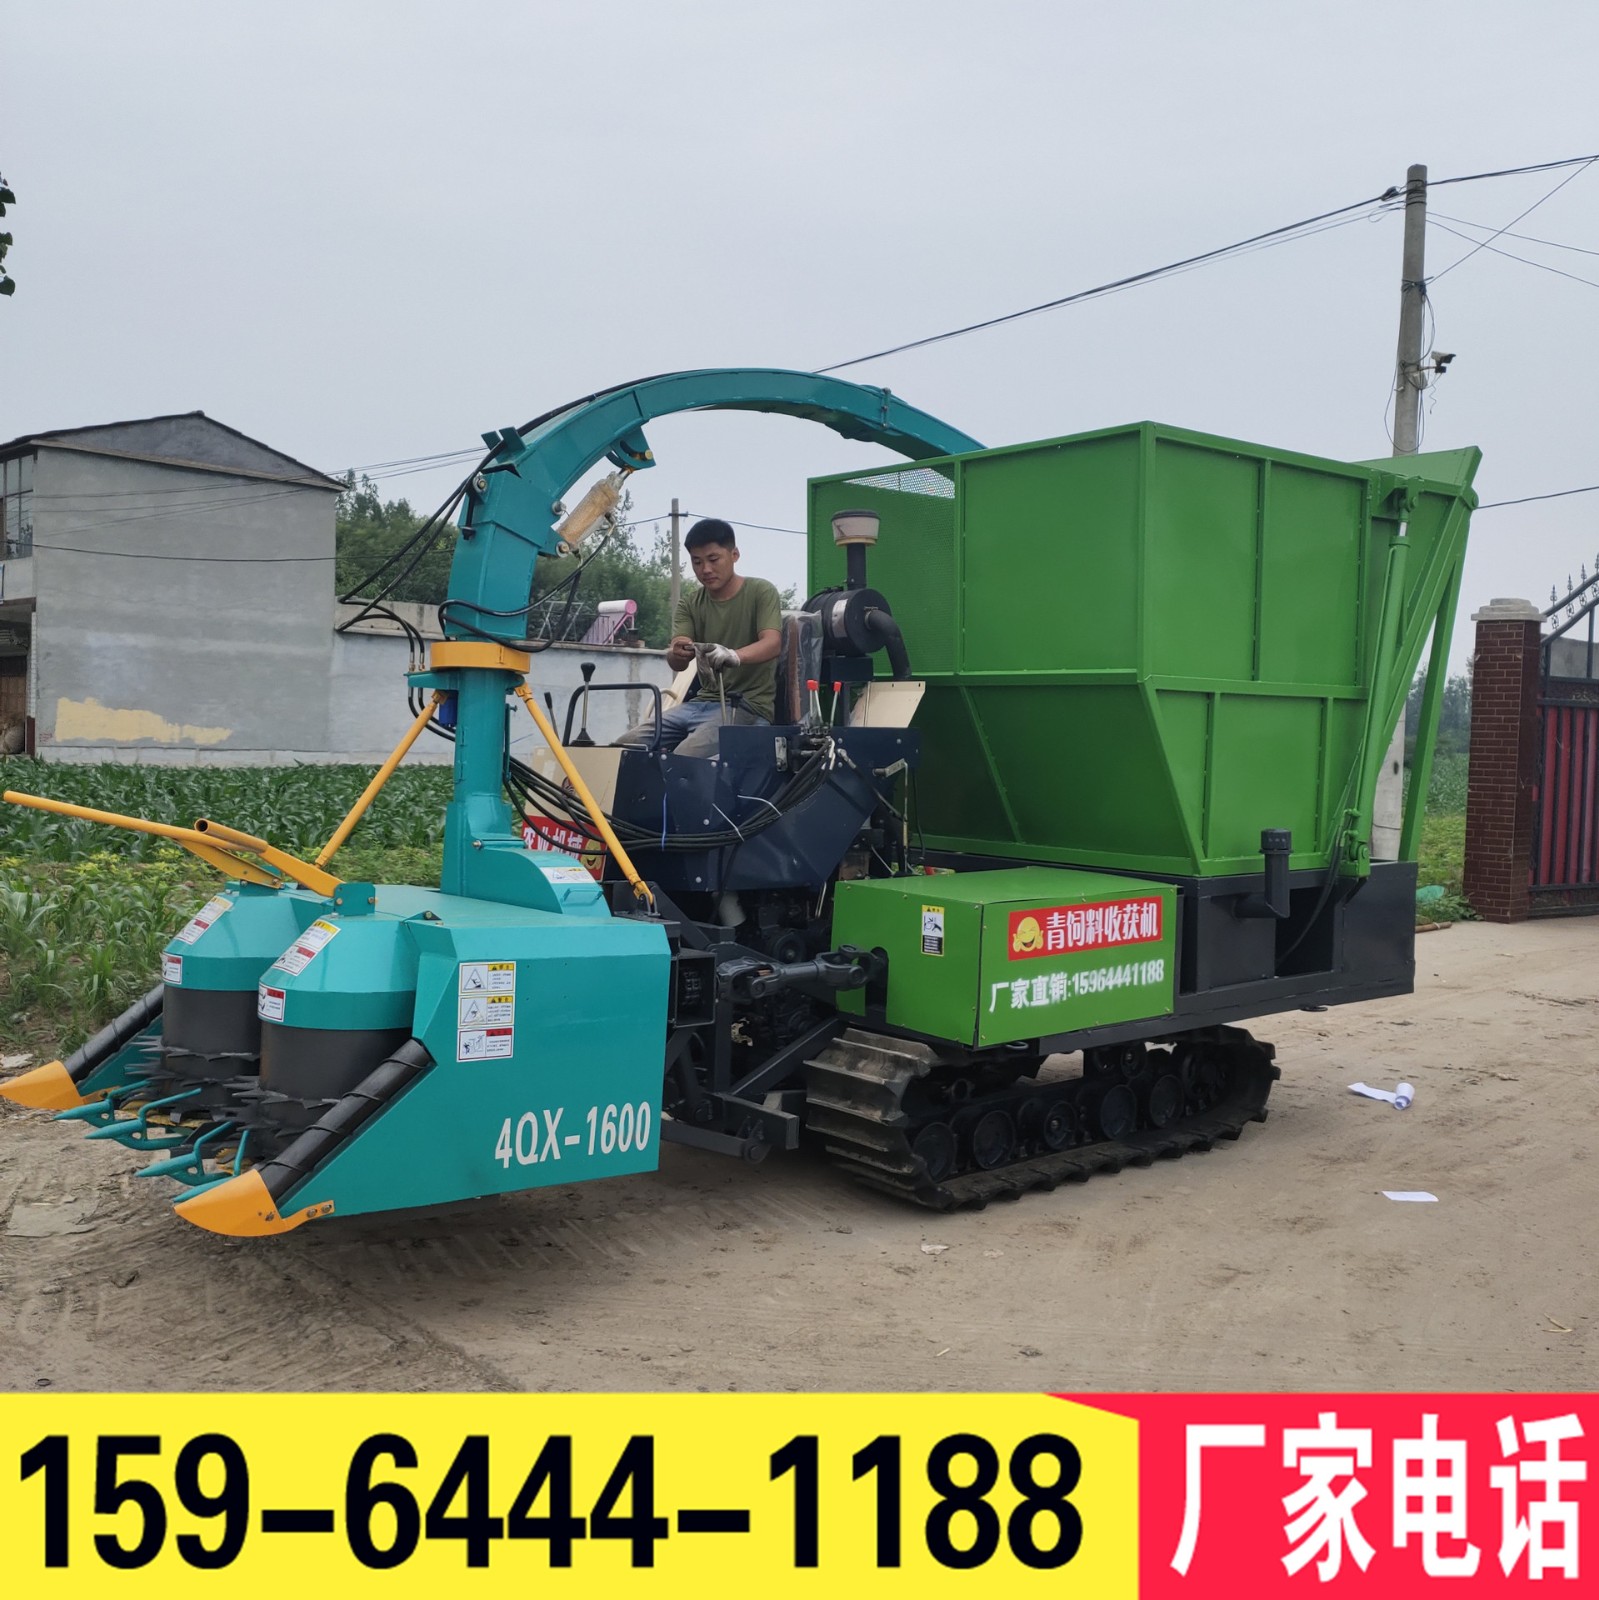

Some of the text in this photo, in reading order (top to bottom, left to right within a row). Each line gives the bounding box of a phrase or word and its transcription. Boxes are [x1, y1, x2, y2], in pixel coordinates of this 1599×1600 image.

[1046, 903, 1157, 950] 青饲料收获机
[495, 1101, 651, 1168] 4QX-1600
